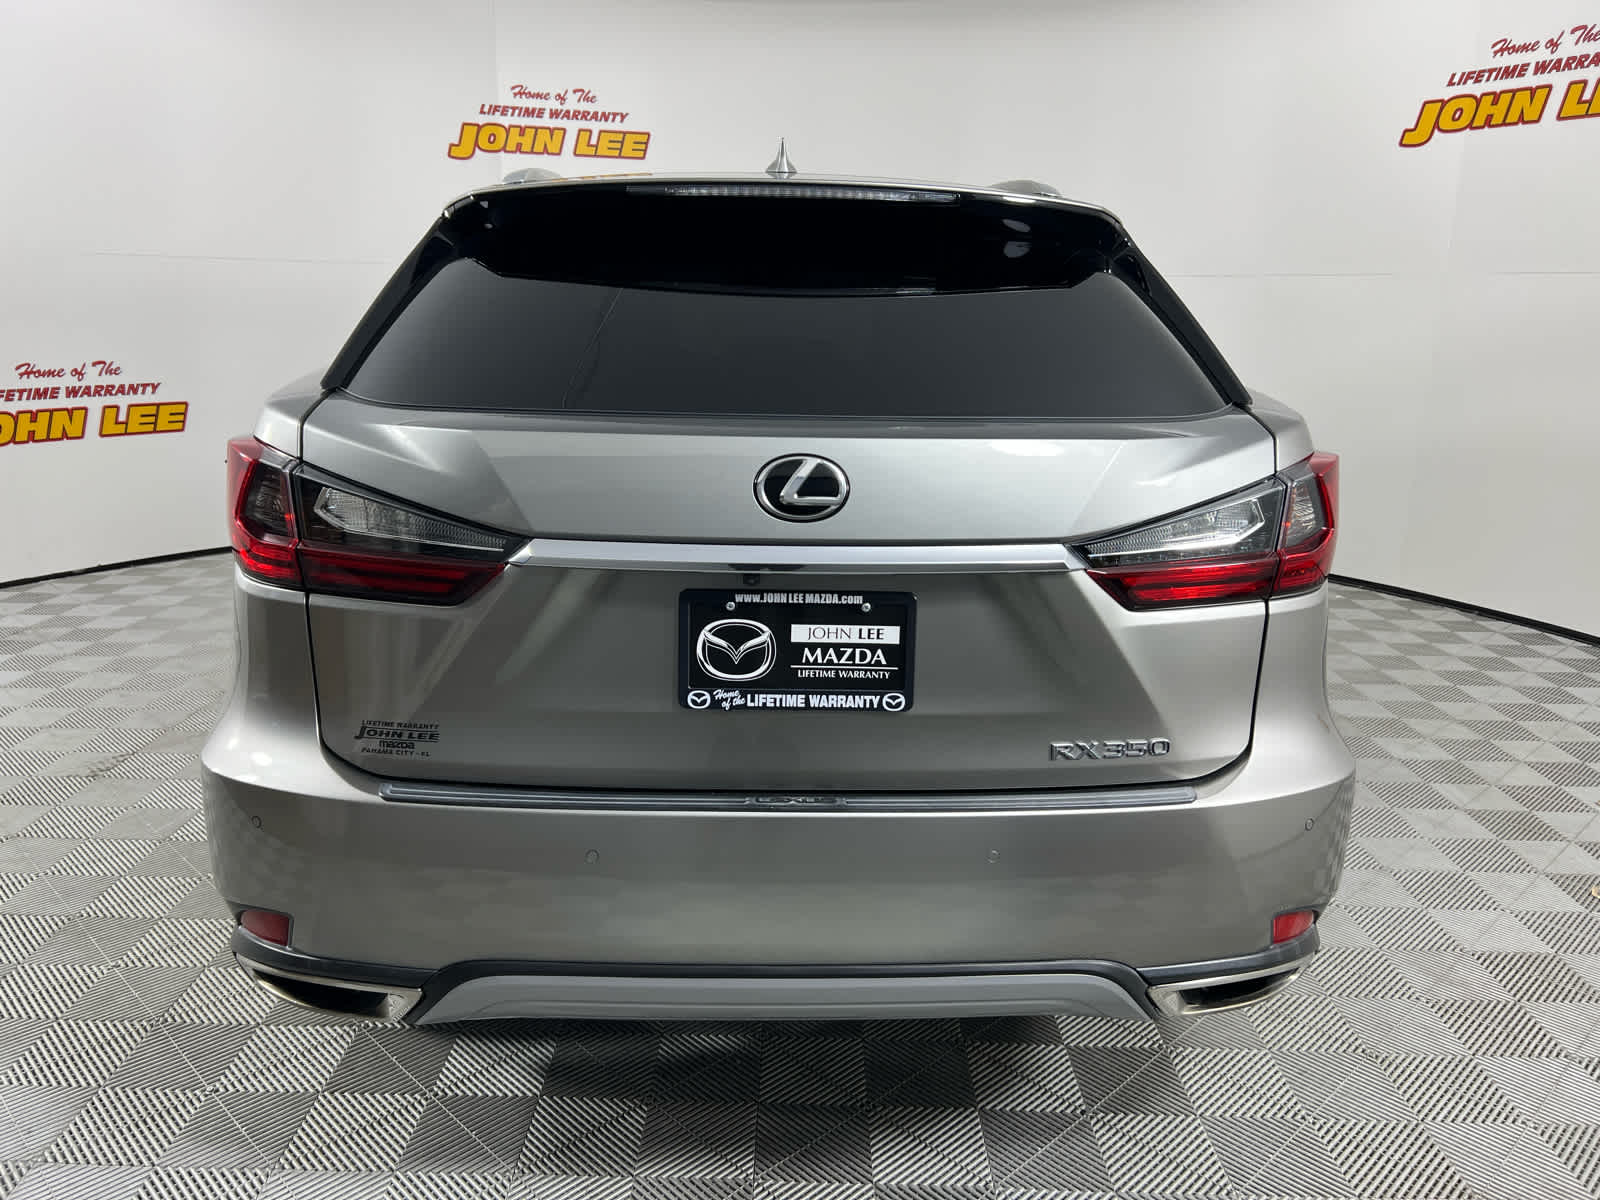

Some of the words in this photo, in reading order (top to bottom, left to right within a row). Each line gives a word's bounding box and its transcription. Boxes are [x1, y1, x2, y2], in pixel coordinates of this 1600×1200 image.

[1490, 38, 1540, 58] Home
[1544, 30, 1565, 54] of
[1447, 62, 1531, 87] LIFETIME
[510, 84, 550, 101] Home
[554, 89, 569, 105] of
[572, 88, 597, 103] The
[479, 103, 545, 119] LIFETIME
[549, 108, 629, 123] WARRANTY
[1398, 83, 1553, 148] JOHN
[448, 122, 566, 160] JOHN
[573, 129, 651, 160] LEE
[15, 362, 65, 380] Home
[70, 362, 86, 382] of
[91, 360, 122, 377] The
[64, 382, 162, 399] WARRANTY
[99, 401, 189, 438] LEE
[788, 593, 804, 604] LEE
[807, 626, 852, 641] JOHN
[858, 627, 885, 640] LEE
[802, 648, 888, 665] MAZDA
[797, 669, 836, 679] LIFETIME
[838, 670, 891, 680] WARRANTY
[713, 689, 740, 700] Home
[746, 693, 806, 707] LIFETIME
[808, 694, 881, 709] WARRANTY
[721, 697, 731, 711] of
[354, 726, 403, 740] JOHN
[407, 732, 440, 741] LEE
